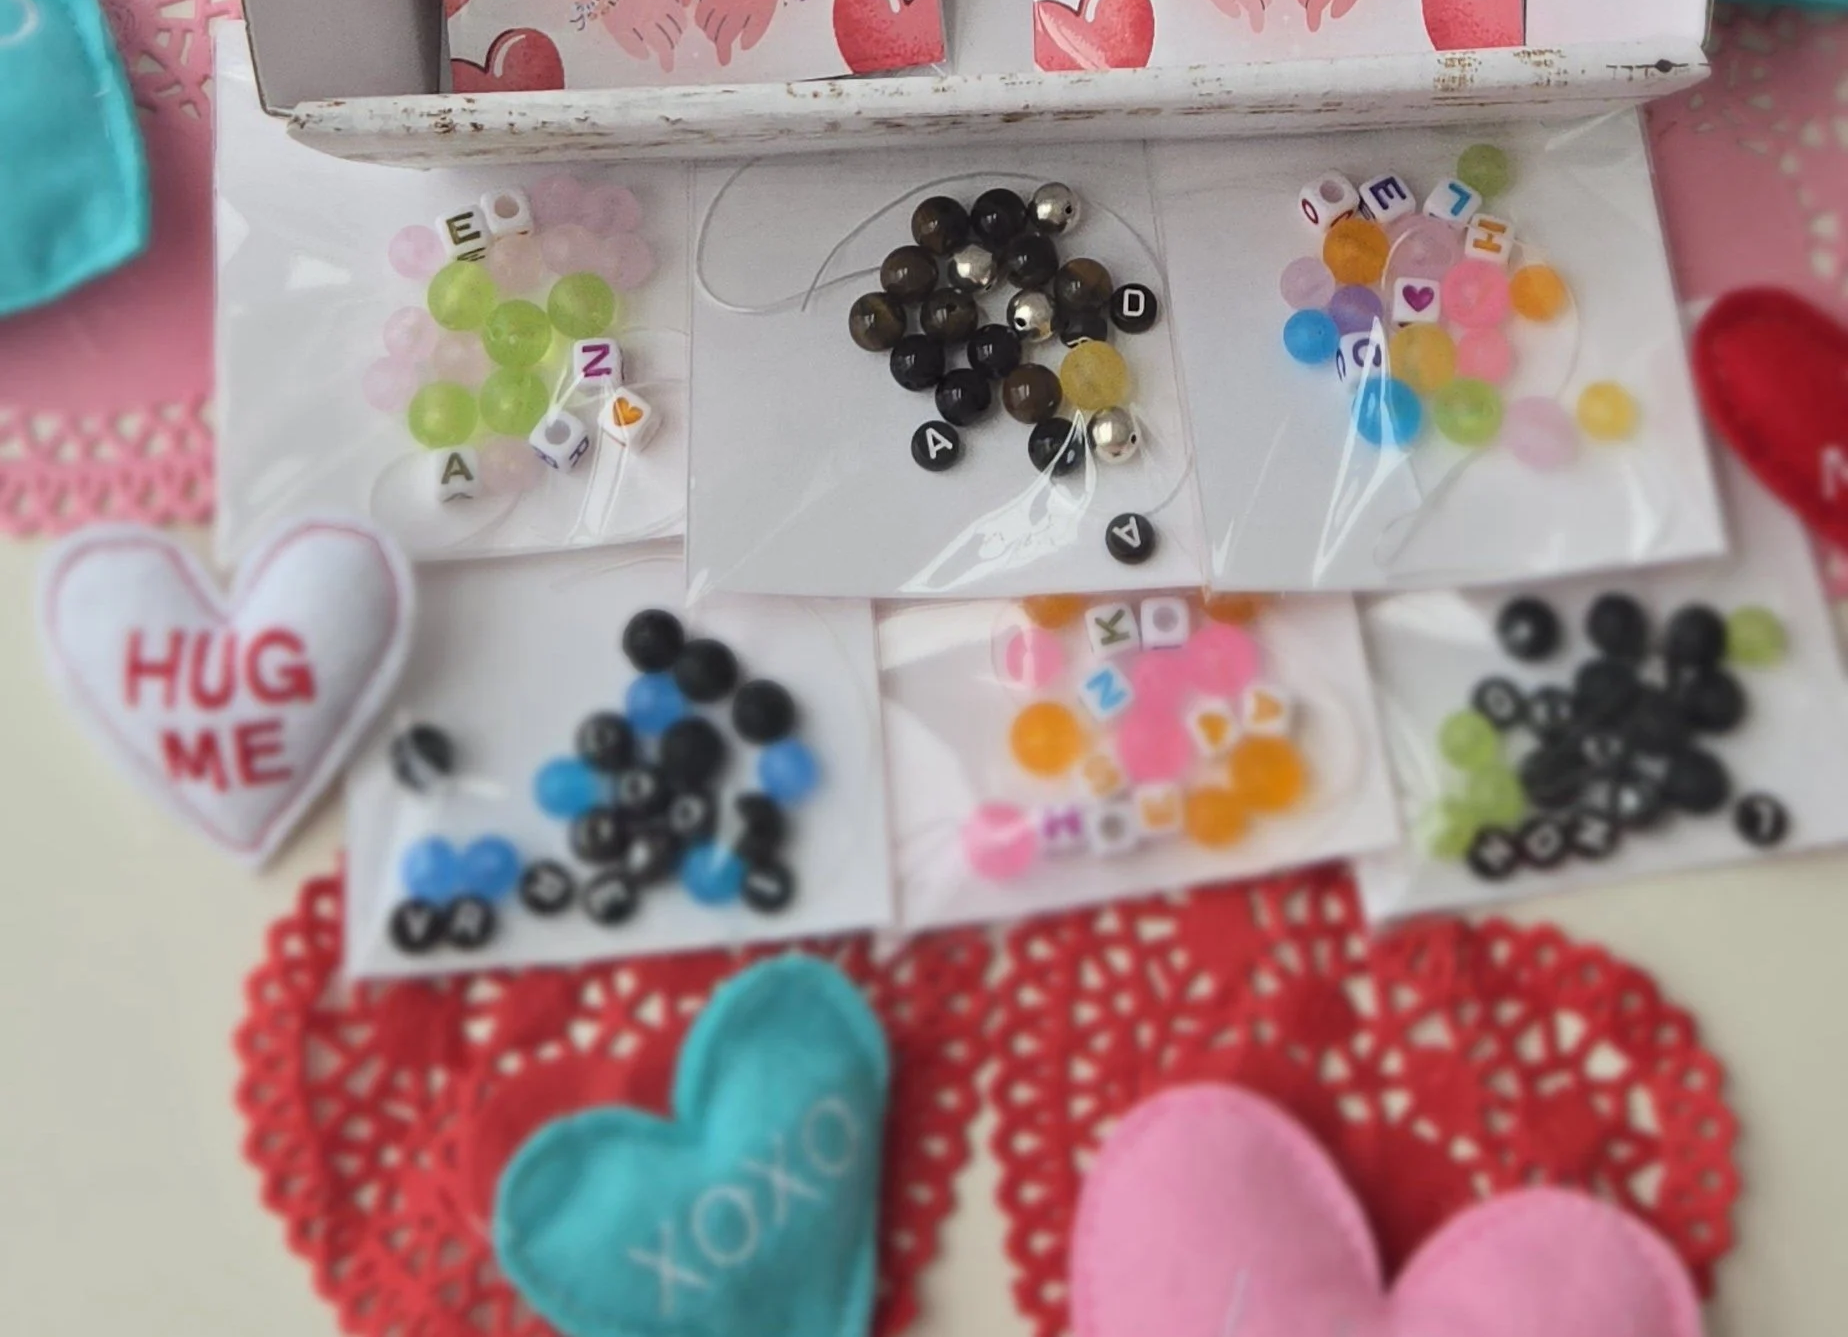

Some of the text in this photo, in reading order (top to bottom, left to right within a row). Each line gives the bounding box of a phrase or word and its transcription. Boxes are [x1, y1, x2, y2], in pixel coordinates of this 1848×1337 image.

[122, 626, 317, 712] HUG
[160, 718, 293, 793] ME
[627, 1097, 861, 1317] XOXO
